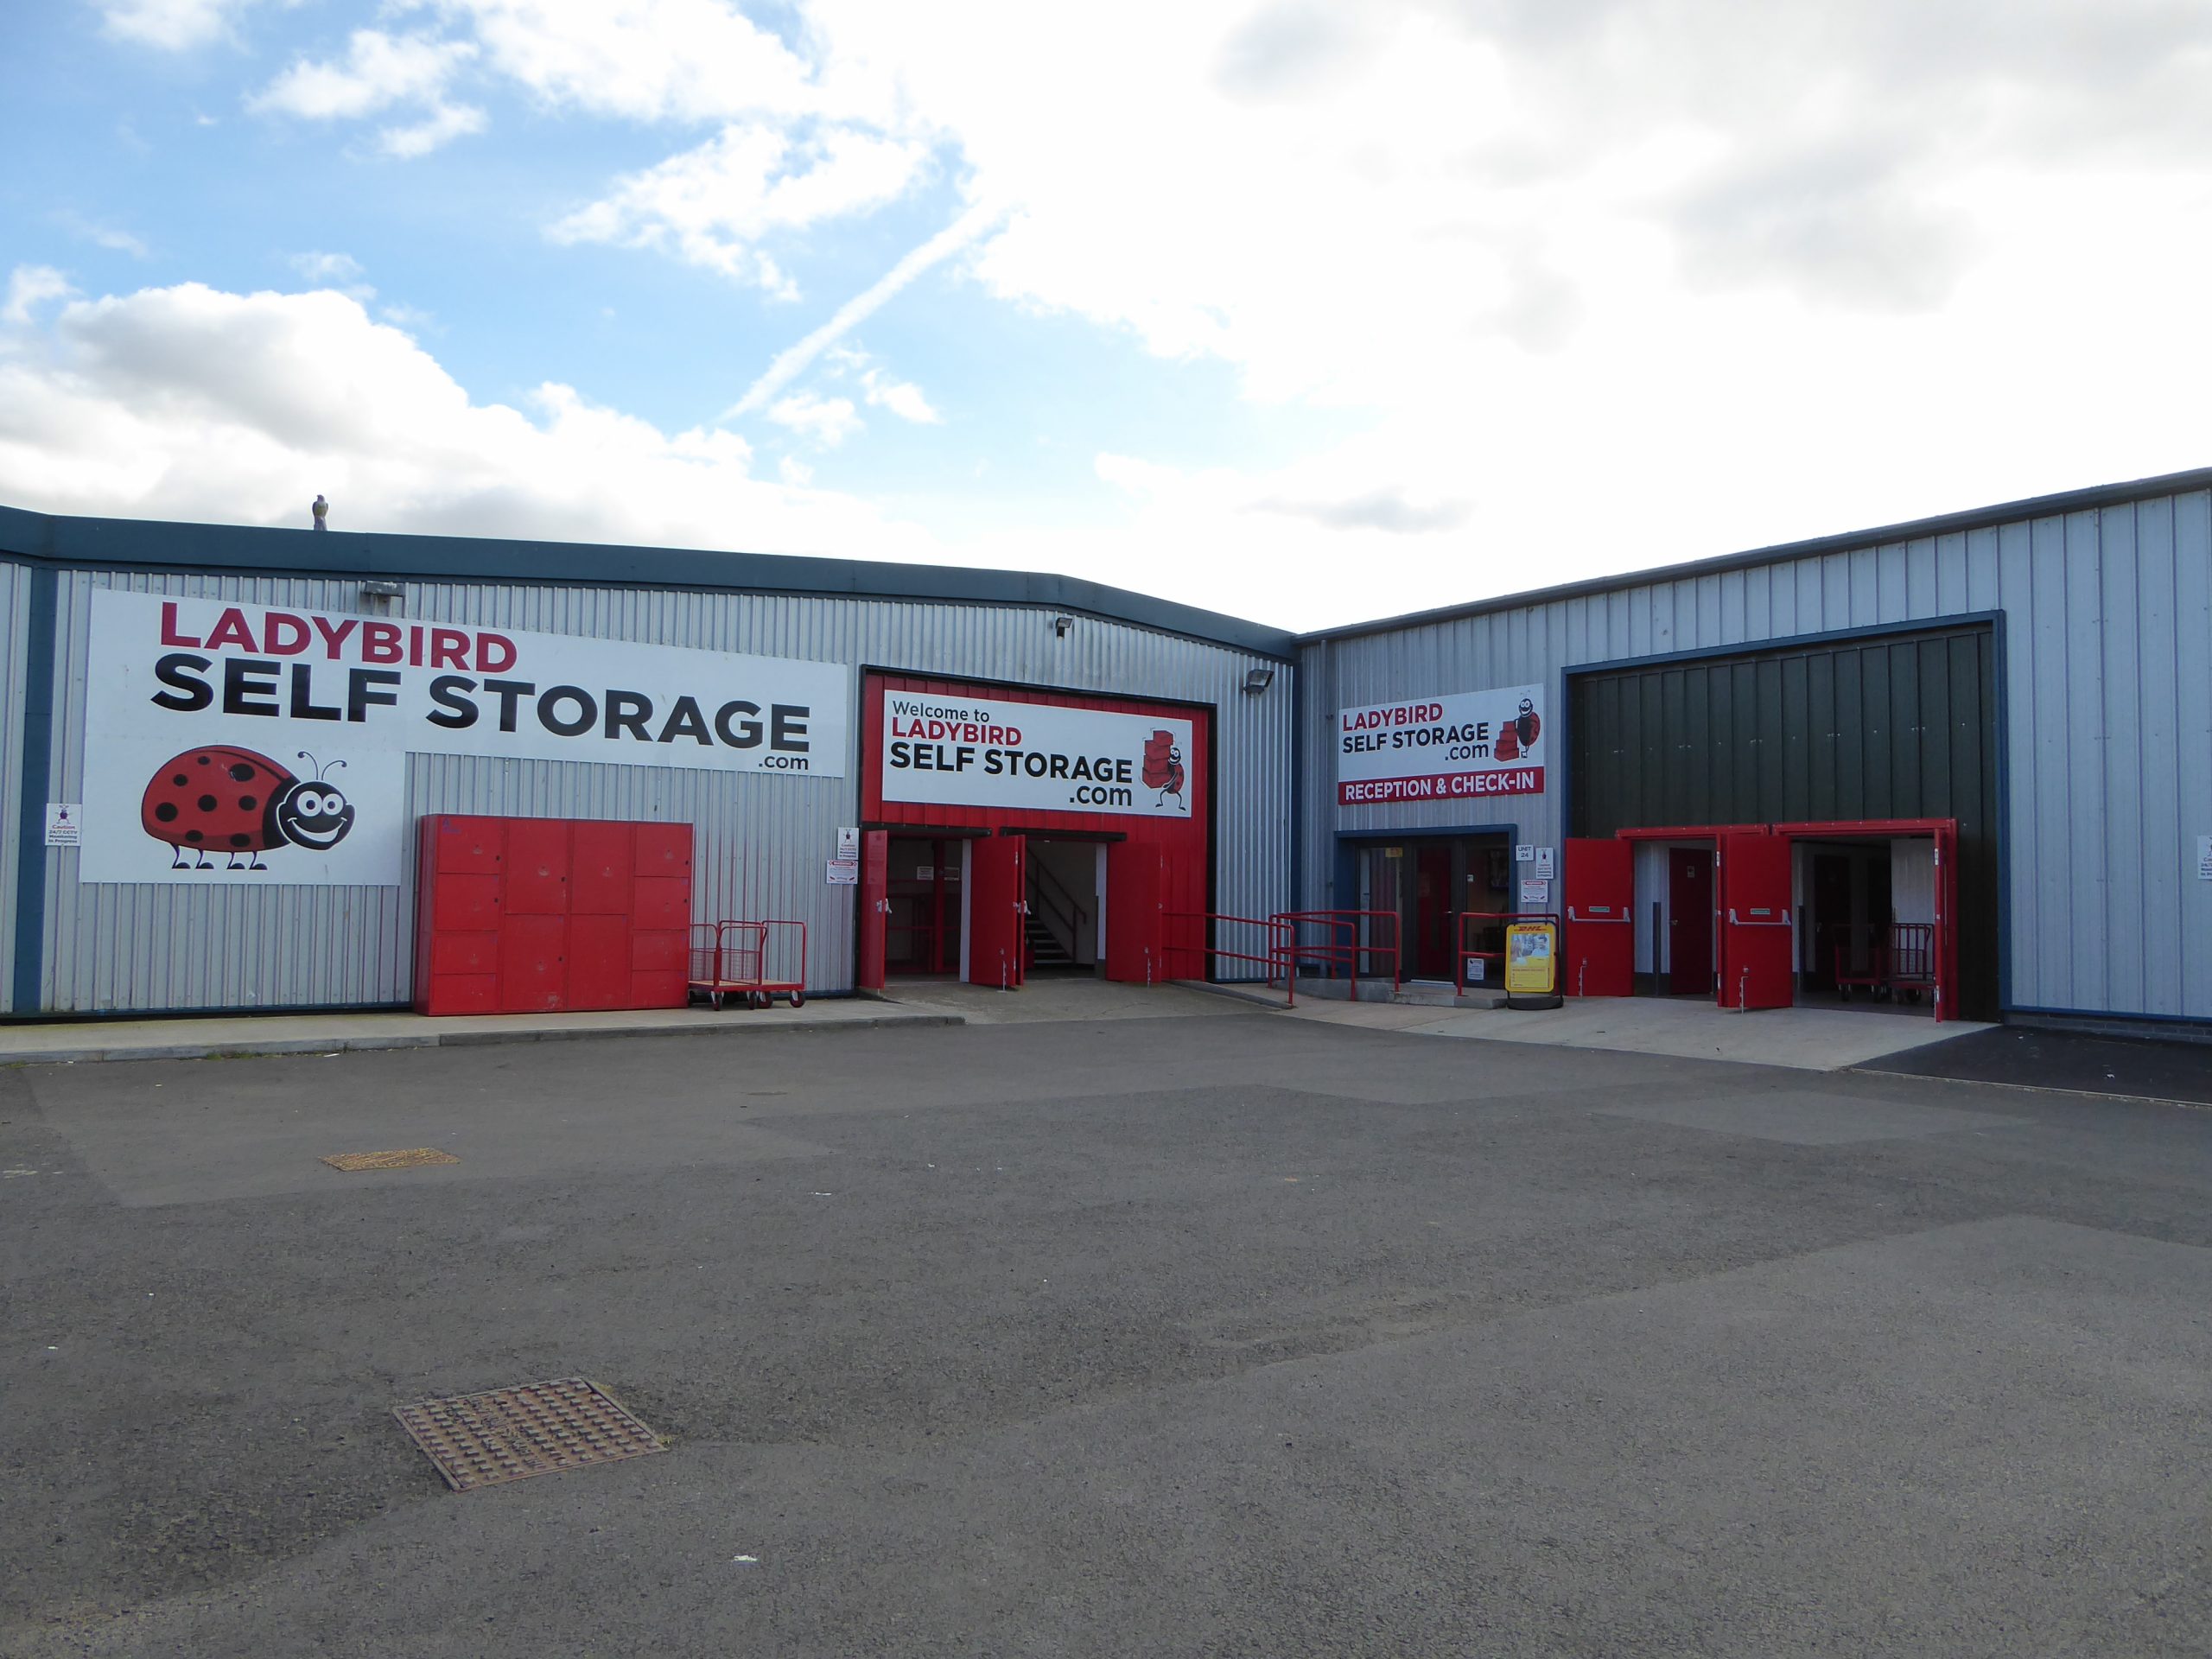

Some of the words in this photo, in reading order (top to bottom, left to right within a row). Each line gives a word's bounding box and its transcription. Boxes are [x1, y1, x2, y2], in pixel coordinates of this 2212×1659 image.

[161, 601, 518, 673] LADYBIRD
[150, 653, 402, 723] SELF
[426, 674, 810, 753] STORAGE
[893, 700, 969, 721] Welcome
[974, 709, 990, 723] to
[1343, 702, 1443, 732] LADYBIRD
[892, 716, 1022, 747] LADYBIRD
[1342, 732, 1388, 754] SELF
[1392, 721, 1490, 749] STORAGE
[757, 754, 810, 771] .com
[890, 741, 976, 772] SELF
[983, 748, 1133, 784] STORAGE
[1445, 743, 1490, 761] .com
[1069, 785, 1132, 807] .com
[1345, 779, 1432, 801] RECEPTION
[1436, 778, 1446, 795] &
[1452, 771, 1535, 793] CHECK-IN
